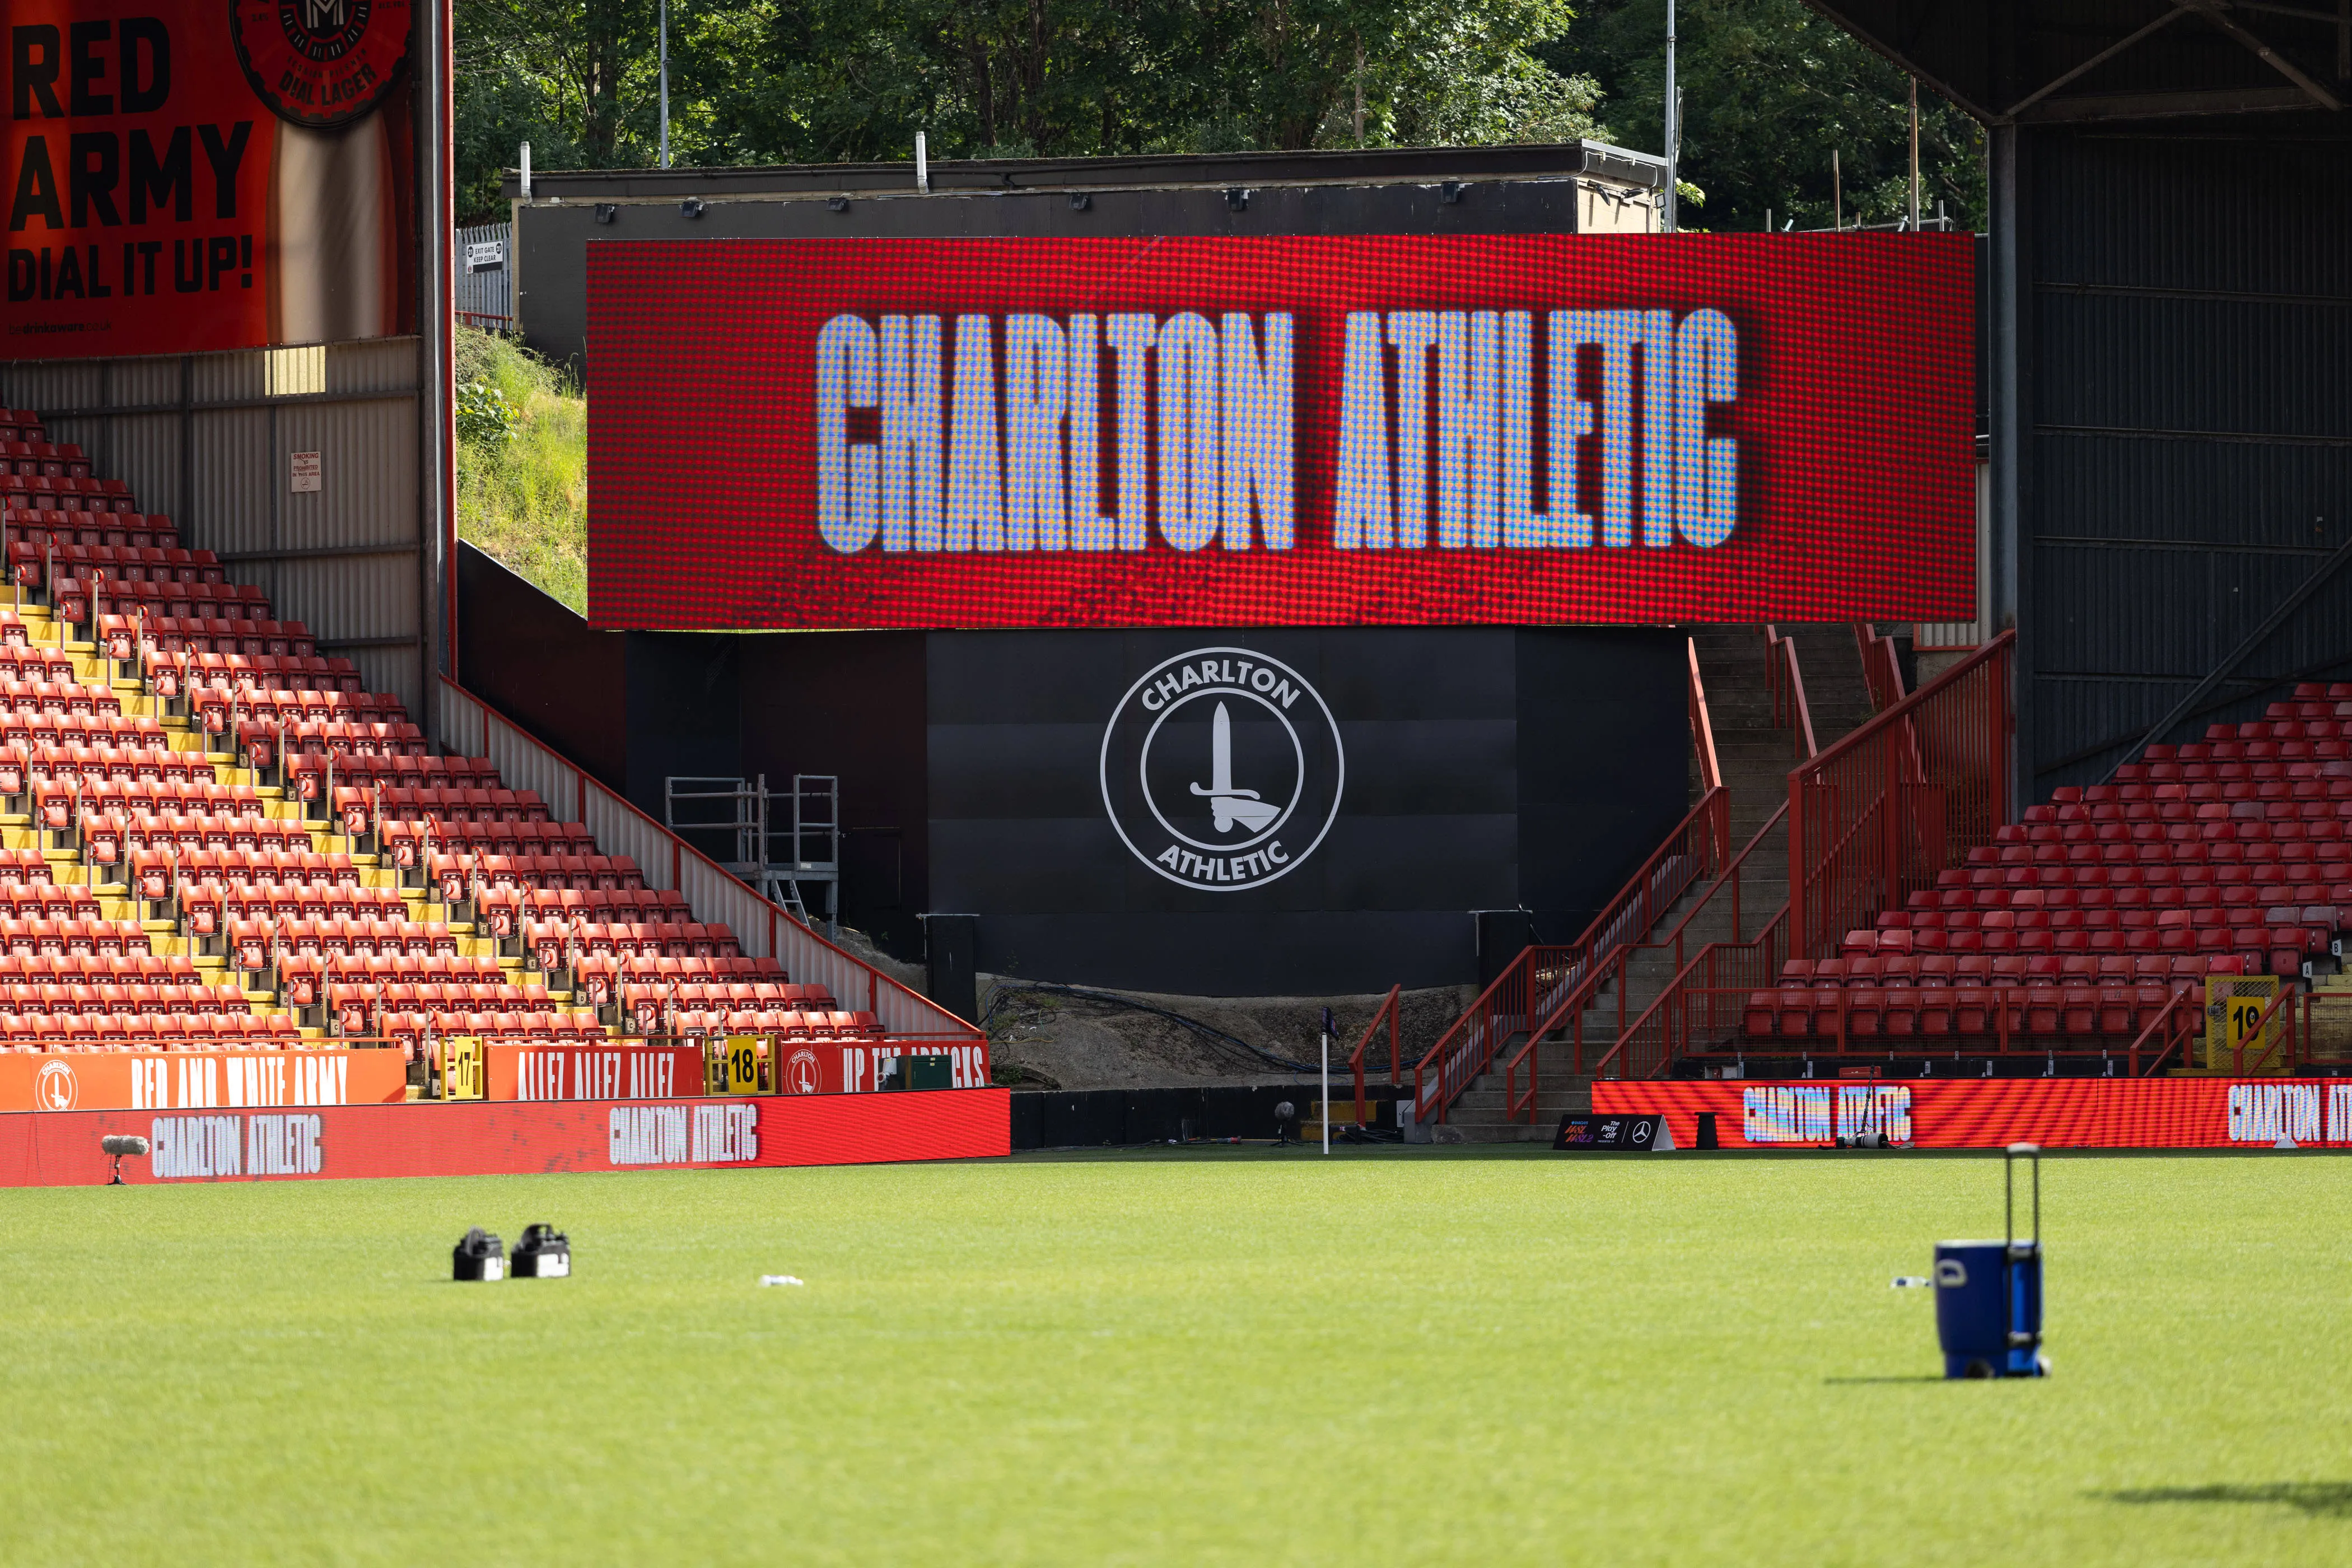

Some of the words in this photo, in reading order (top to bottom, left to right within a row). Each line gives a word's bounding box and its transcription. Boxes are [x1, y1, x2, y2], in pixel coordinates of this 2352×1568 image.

[12, 16, 171, 120] RED
[278, 69, 315, 106] DIAL
[321, 62, 378, 106] LAGER
[9, 120, 254, 231] ARMY
[8, 245, 111, 302] DIAL
[123, 240, 162, 296] IT
[174, 234, 254, 293] UP!
[815, 310, 1295, 554] CHARLTON
[1333, 306, 1739, 551] ATHLETIC
[1142, 660, 1301, 711] CHARLTON
[1156, 840, 1290, 881] ATHLETIC
[2305, 965, 2309, 975] A
[2334, 943, 2339, 953] B
[2233, 1005, 2260, 1042] 19
[41, 1062, 71, 1076] CHARLTON
[458, 1051, 471, 1086] 17
[731, 1048, 755, 1084] 18
[791, 1051, 815, 1064] CHARLTON
[843, 1048, 865, 1093] UP
[131, 1058, 168, 1108] RED
[178, 1057, 217, 1107] AND
[226, 1056, 286, 1106] WHITE
[294, 1056, 348, 1105] ARMY
[609, 1105, 687, 1165] CHARLTON
[692, 1104, 758, 1162] ATHLETIC
[1743, 1086, 1831, 1142] CHARLTON
[2228, 1084, 2320, 1141] CHARLTON
[152, 1116, 241, 1178] CHARLTON
[247, 1114, 321, 1175] ATHLETIC
